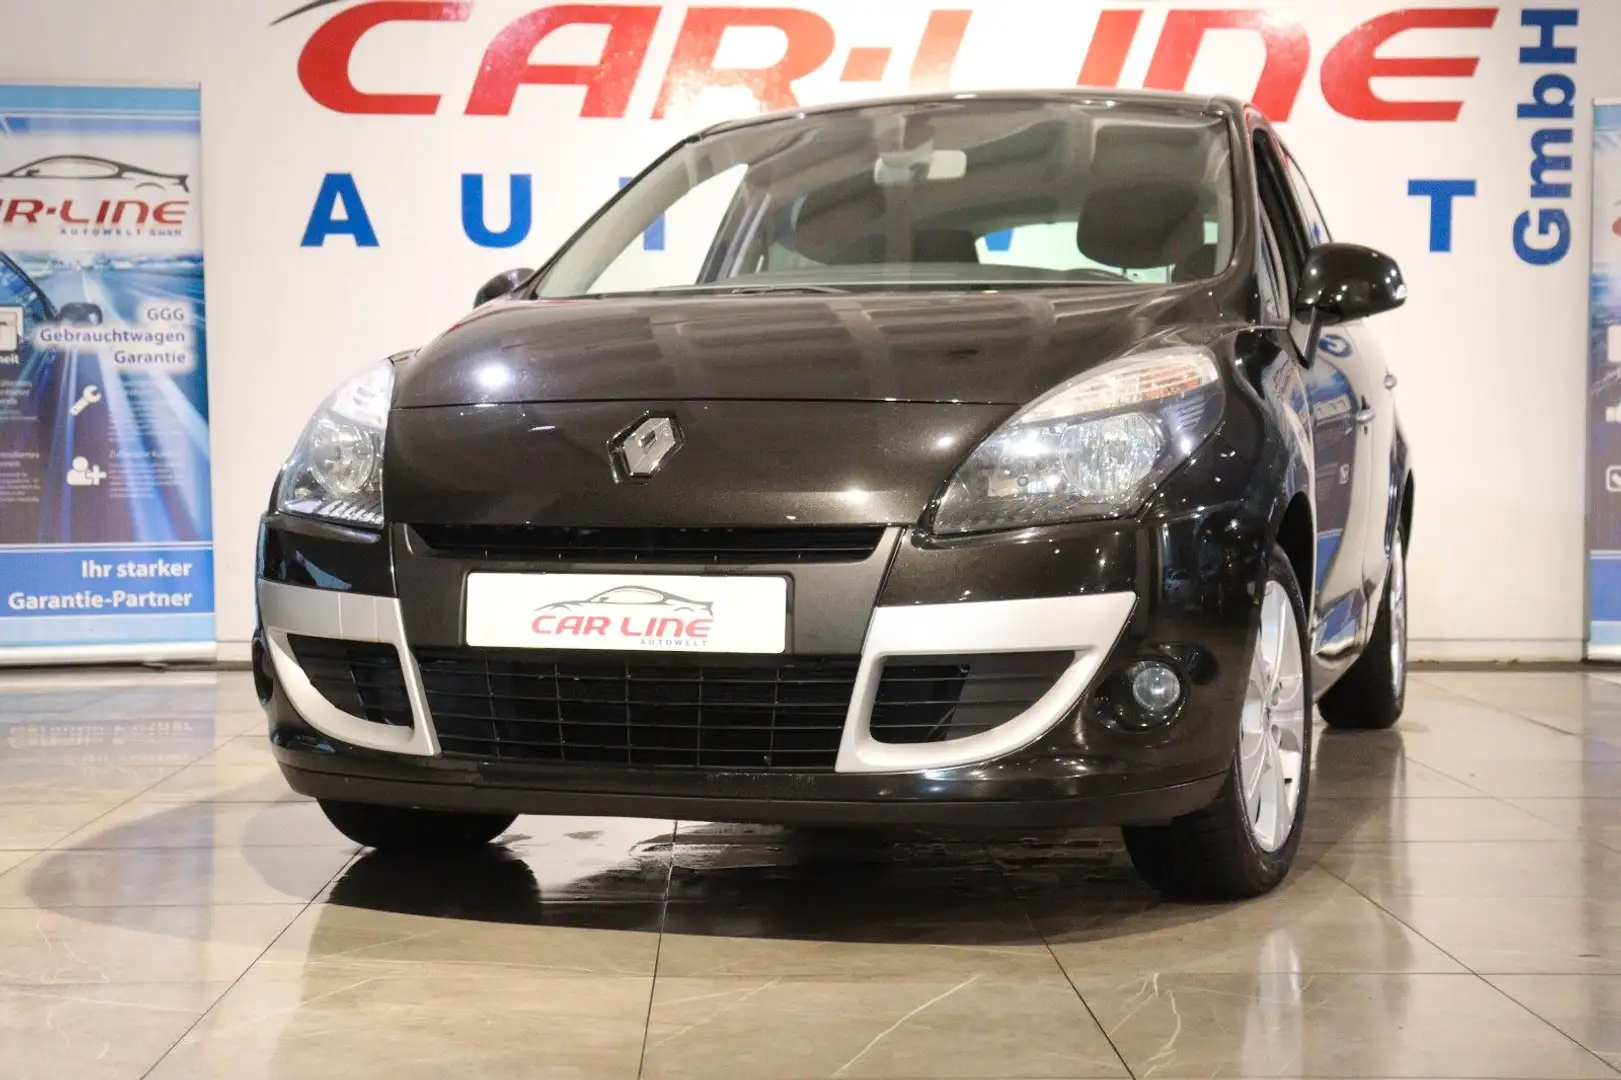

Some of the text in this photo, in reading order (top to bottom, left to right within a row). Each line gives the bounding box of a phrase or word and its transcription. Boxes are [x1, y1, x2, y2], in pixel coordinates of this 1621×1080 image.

[1512, 8, 1579, 266] GmbH
[0, 199, 189, 225] R-LINE
[60, 228, 141, 236] AUTOWELT
[147, 309, 184, 321] GGG
[40, 328, 185, 345] Gebrauchtwagen
[114, 351, 186, 364] Garantie
[82, 559, 192, 577] Ihr starker
[8, 591, 192, 609] Garantie-Partner
[531, 615, 713, 638] CAR LINE
[640, 638, 707, 646] AUTOWELT
